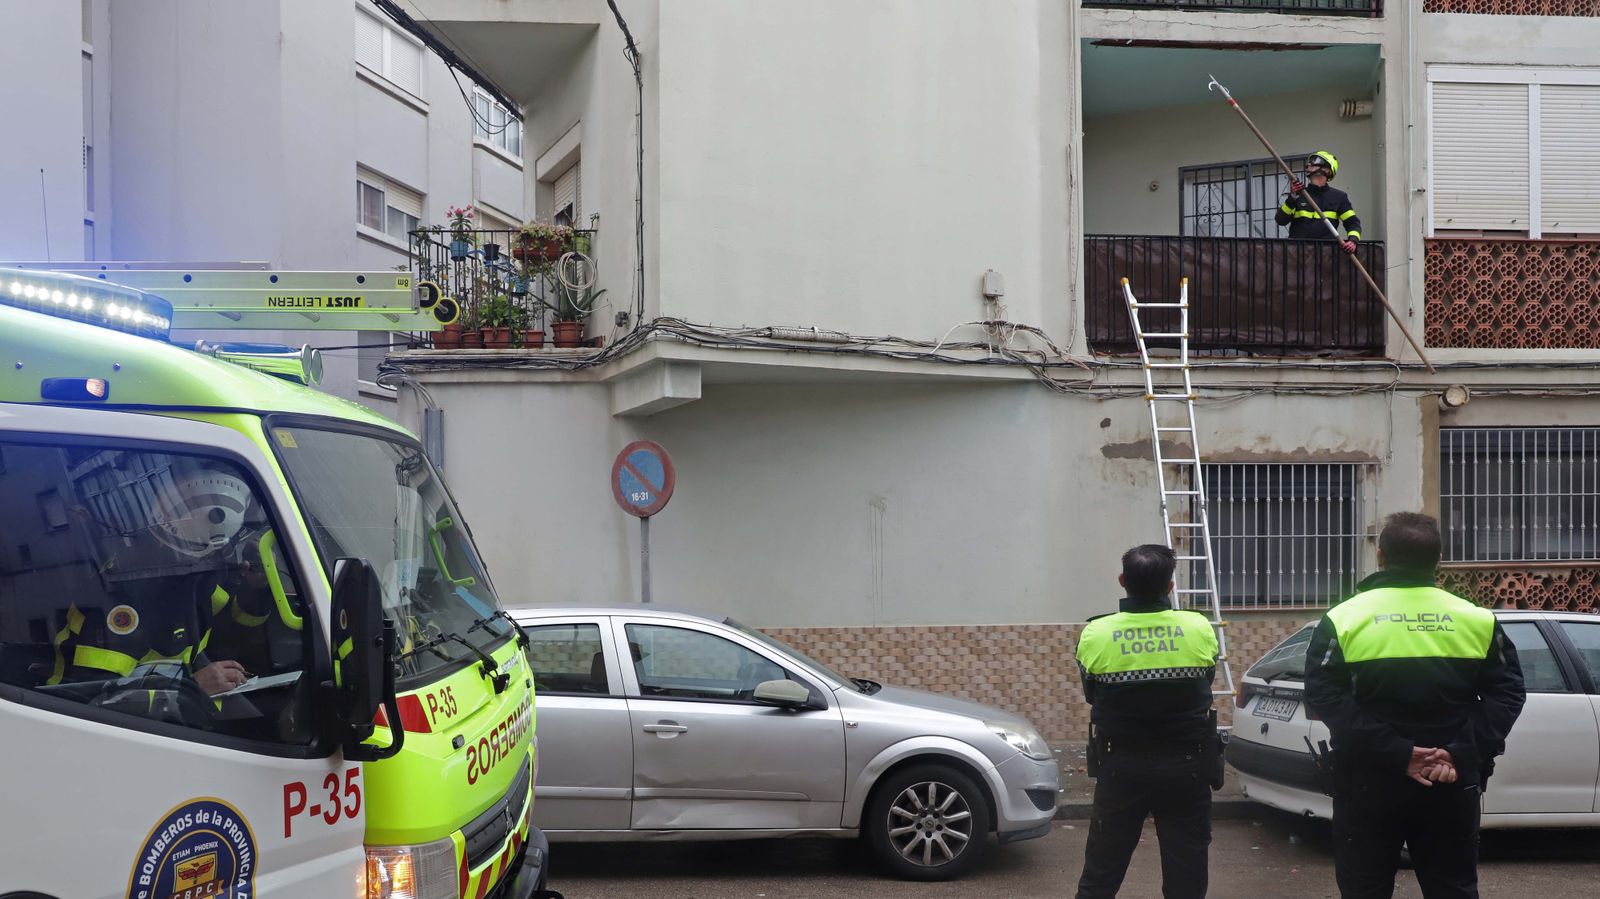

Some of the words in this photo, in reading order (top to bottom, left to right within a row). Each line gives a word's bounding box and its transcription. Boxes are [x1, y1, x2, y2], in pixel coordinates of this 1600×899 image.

[397, 278, 409, 287] 8m
[268, 297, 322, 307] LEITERN
[326, 297, 361, 307] JUST
[632, 491, 649, 502] 16-31
[1373, 613, 1453, 624] POLICIA
[1112, 626, 1184, 642] POLICIA
[1121, 640, 1179, 655] LOCAL
[426, 686, 457, 725] P-35
[283, 766, 361, 839] P-35
[140, 813, 193, 885] BOMBEROS
[195, 809, 209, 823] de
[212, 810, 223, 826] la
[223, 818, 250, 888] PROVINCIA
[172, 848, 191, 861] ETIAM
[194, 841, 219, 853] PHOENIX
